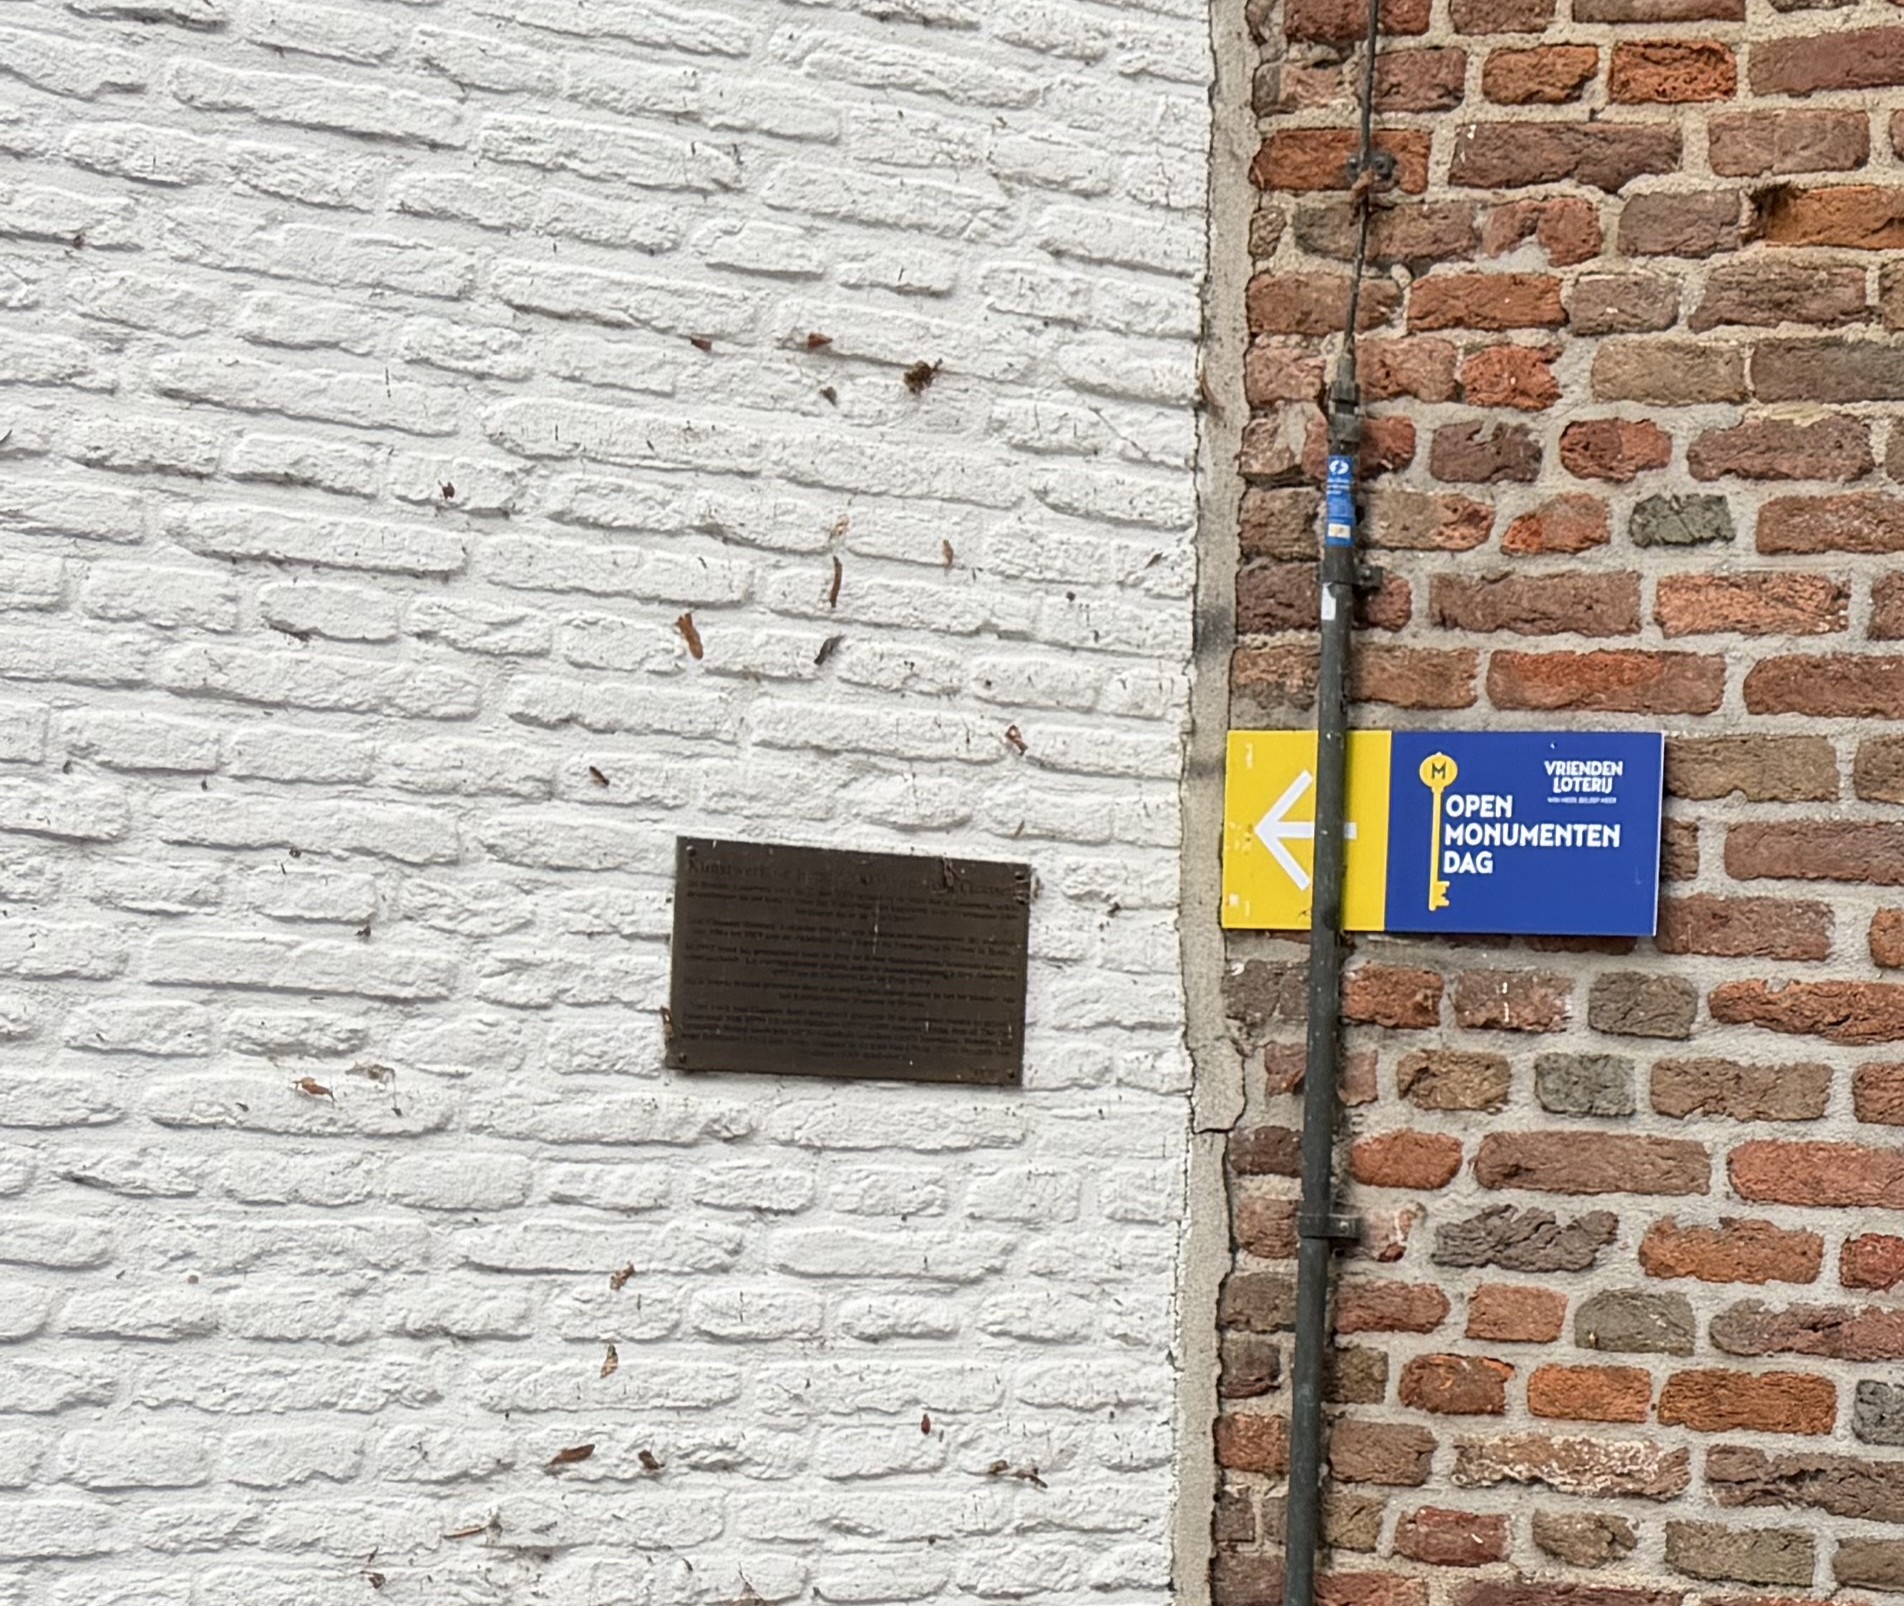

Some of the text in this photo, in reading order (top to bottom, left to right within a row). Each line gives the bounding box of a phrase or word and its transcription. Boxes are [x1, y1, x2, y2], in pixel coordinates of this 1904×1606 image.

[1431, 762, 1446, 779] M
[1543, 760, 1624, 776] VRIENDEN
[1552, 776, 1613, 794] LOTERIJ
[1445, 794, 1513, 819] OPEN
[1444, 822, 1621, 848] MONUMENTEN
[1442, 850, 1494, 874] DAG
